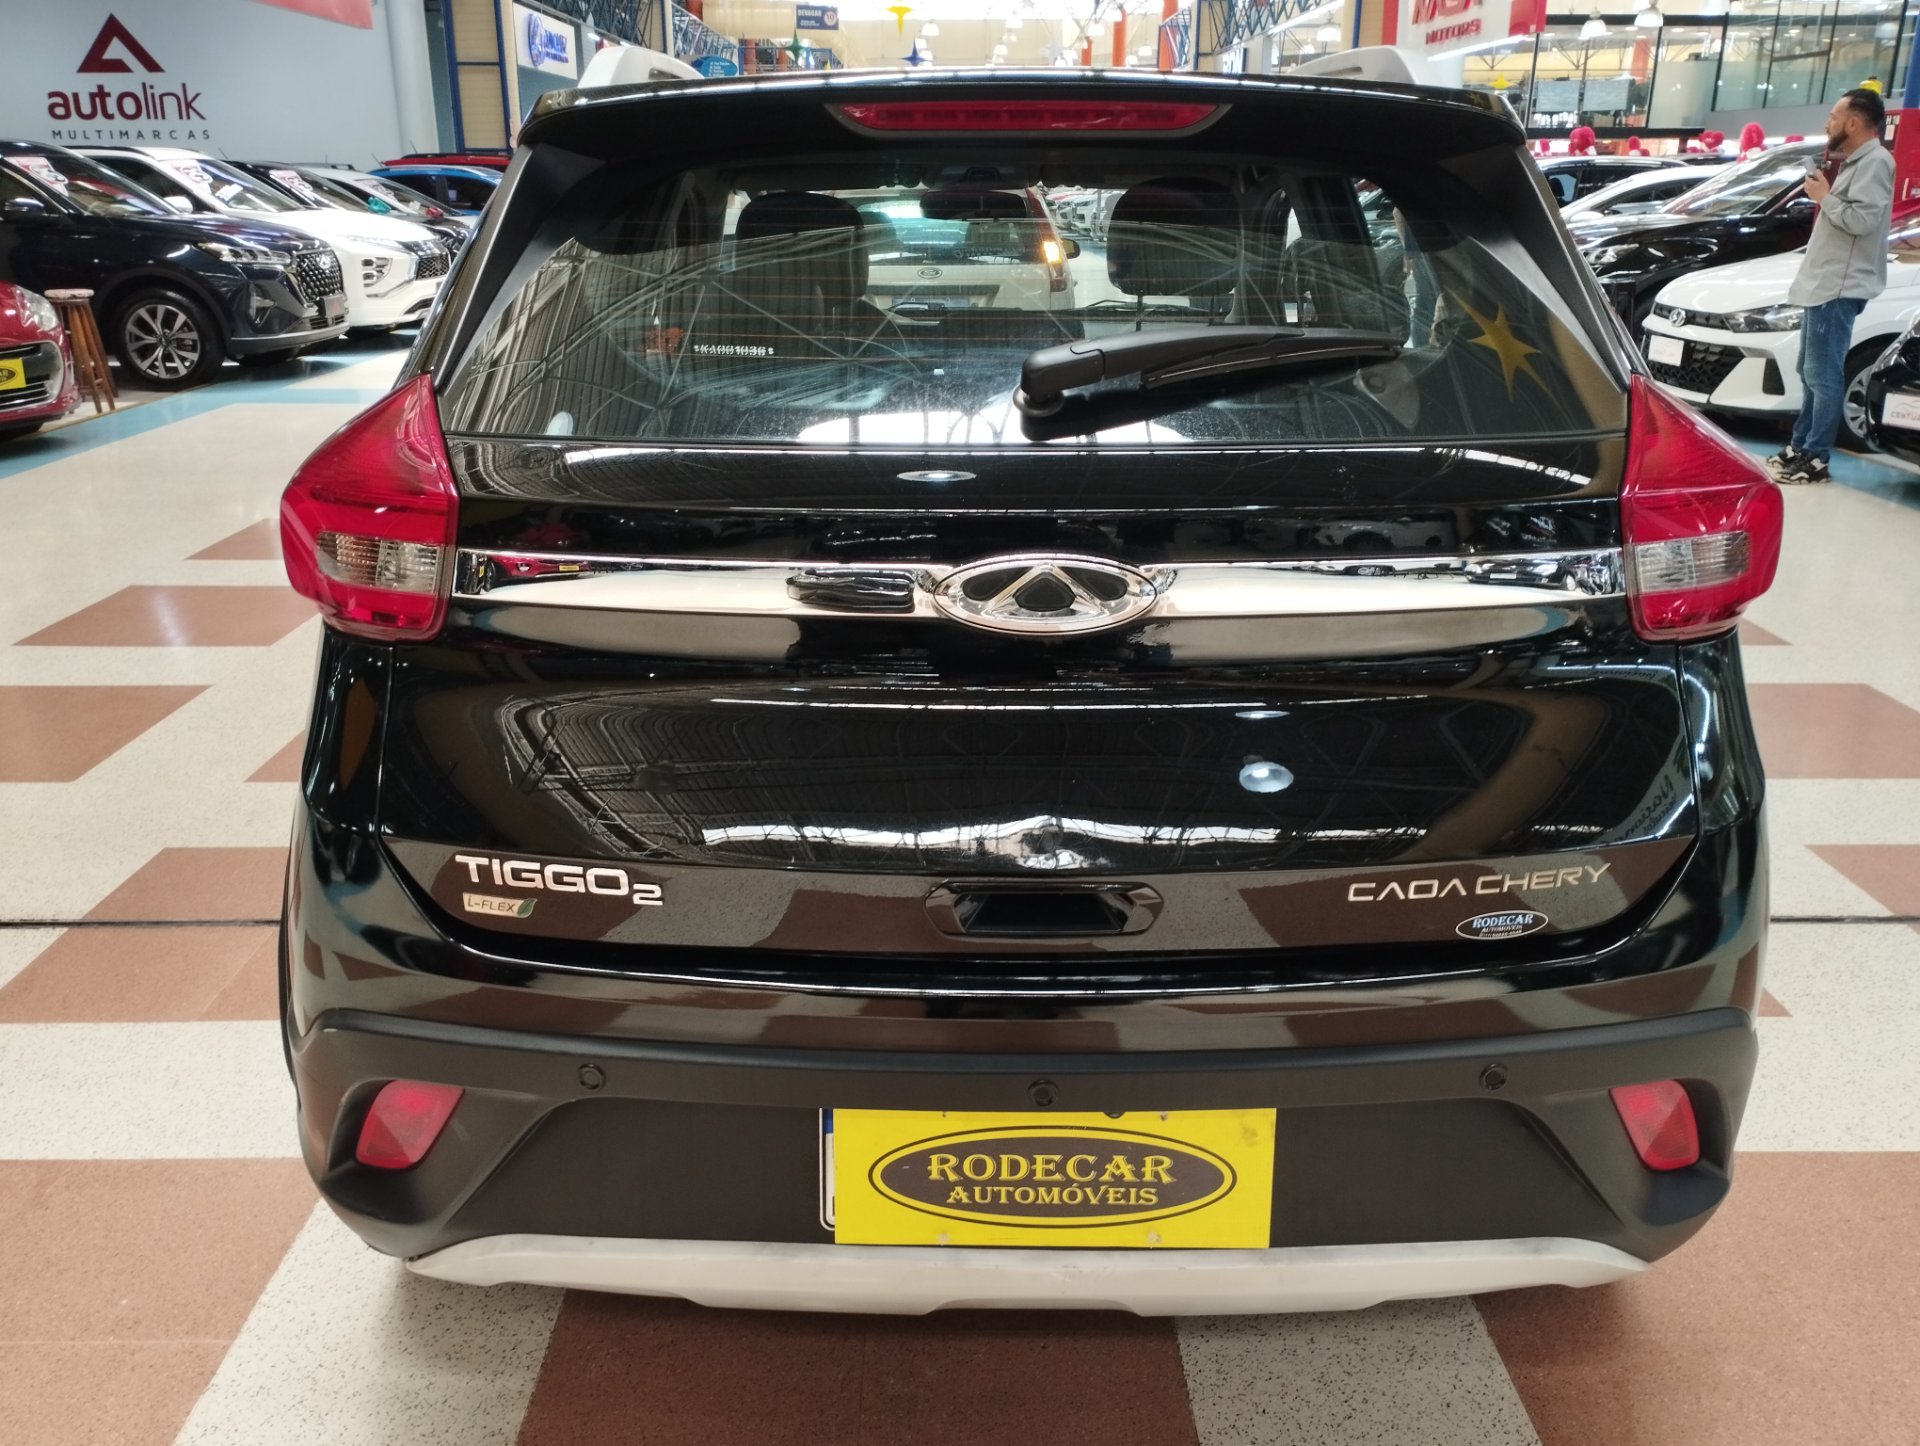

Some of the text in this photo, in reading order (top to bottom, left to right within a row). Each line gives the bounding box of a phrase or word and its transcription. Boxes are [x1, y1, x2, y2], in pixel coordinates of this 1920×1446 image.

[47, 81, 207, 121] autolink
[52, 129, 211, 140] MULTIMARCAS
[1347, 862, 1612, 901] CAOA CHERY
[467, 896, 516, 913] L-FLEX
[1472, 913, 1534, 929] RODECAR
[928, 1153, 1177, 1184] RODECAR
[946, 1183, 1160, 1206] AUTOMÓVEIS
